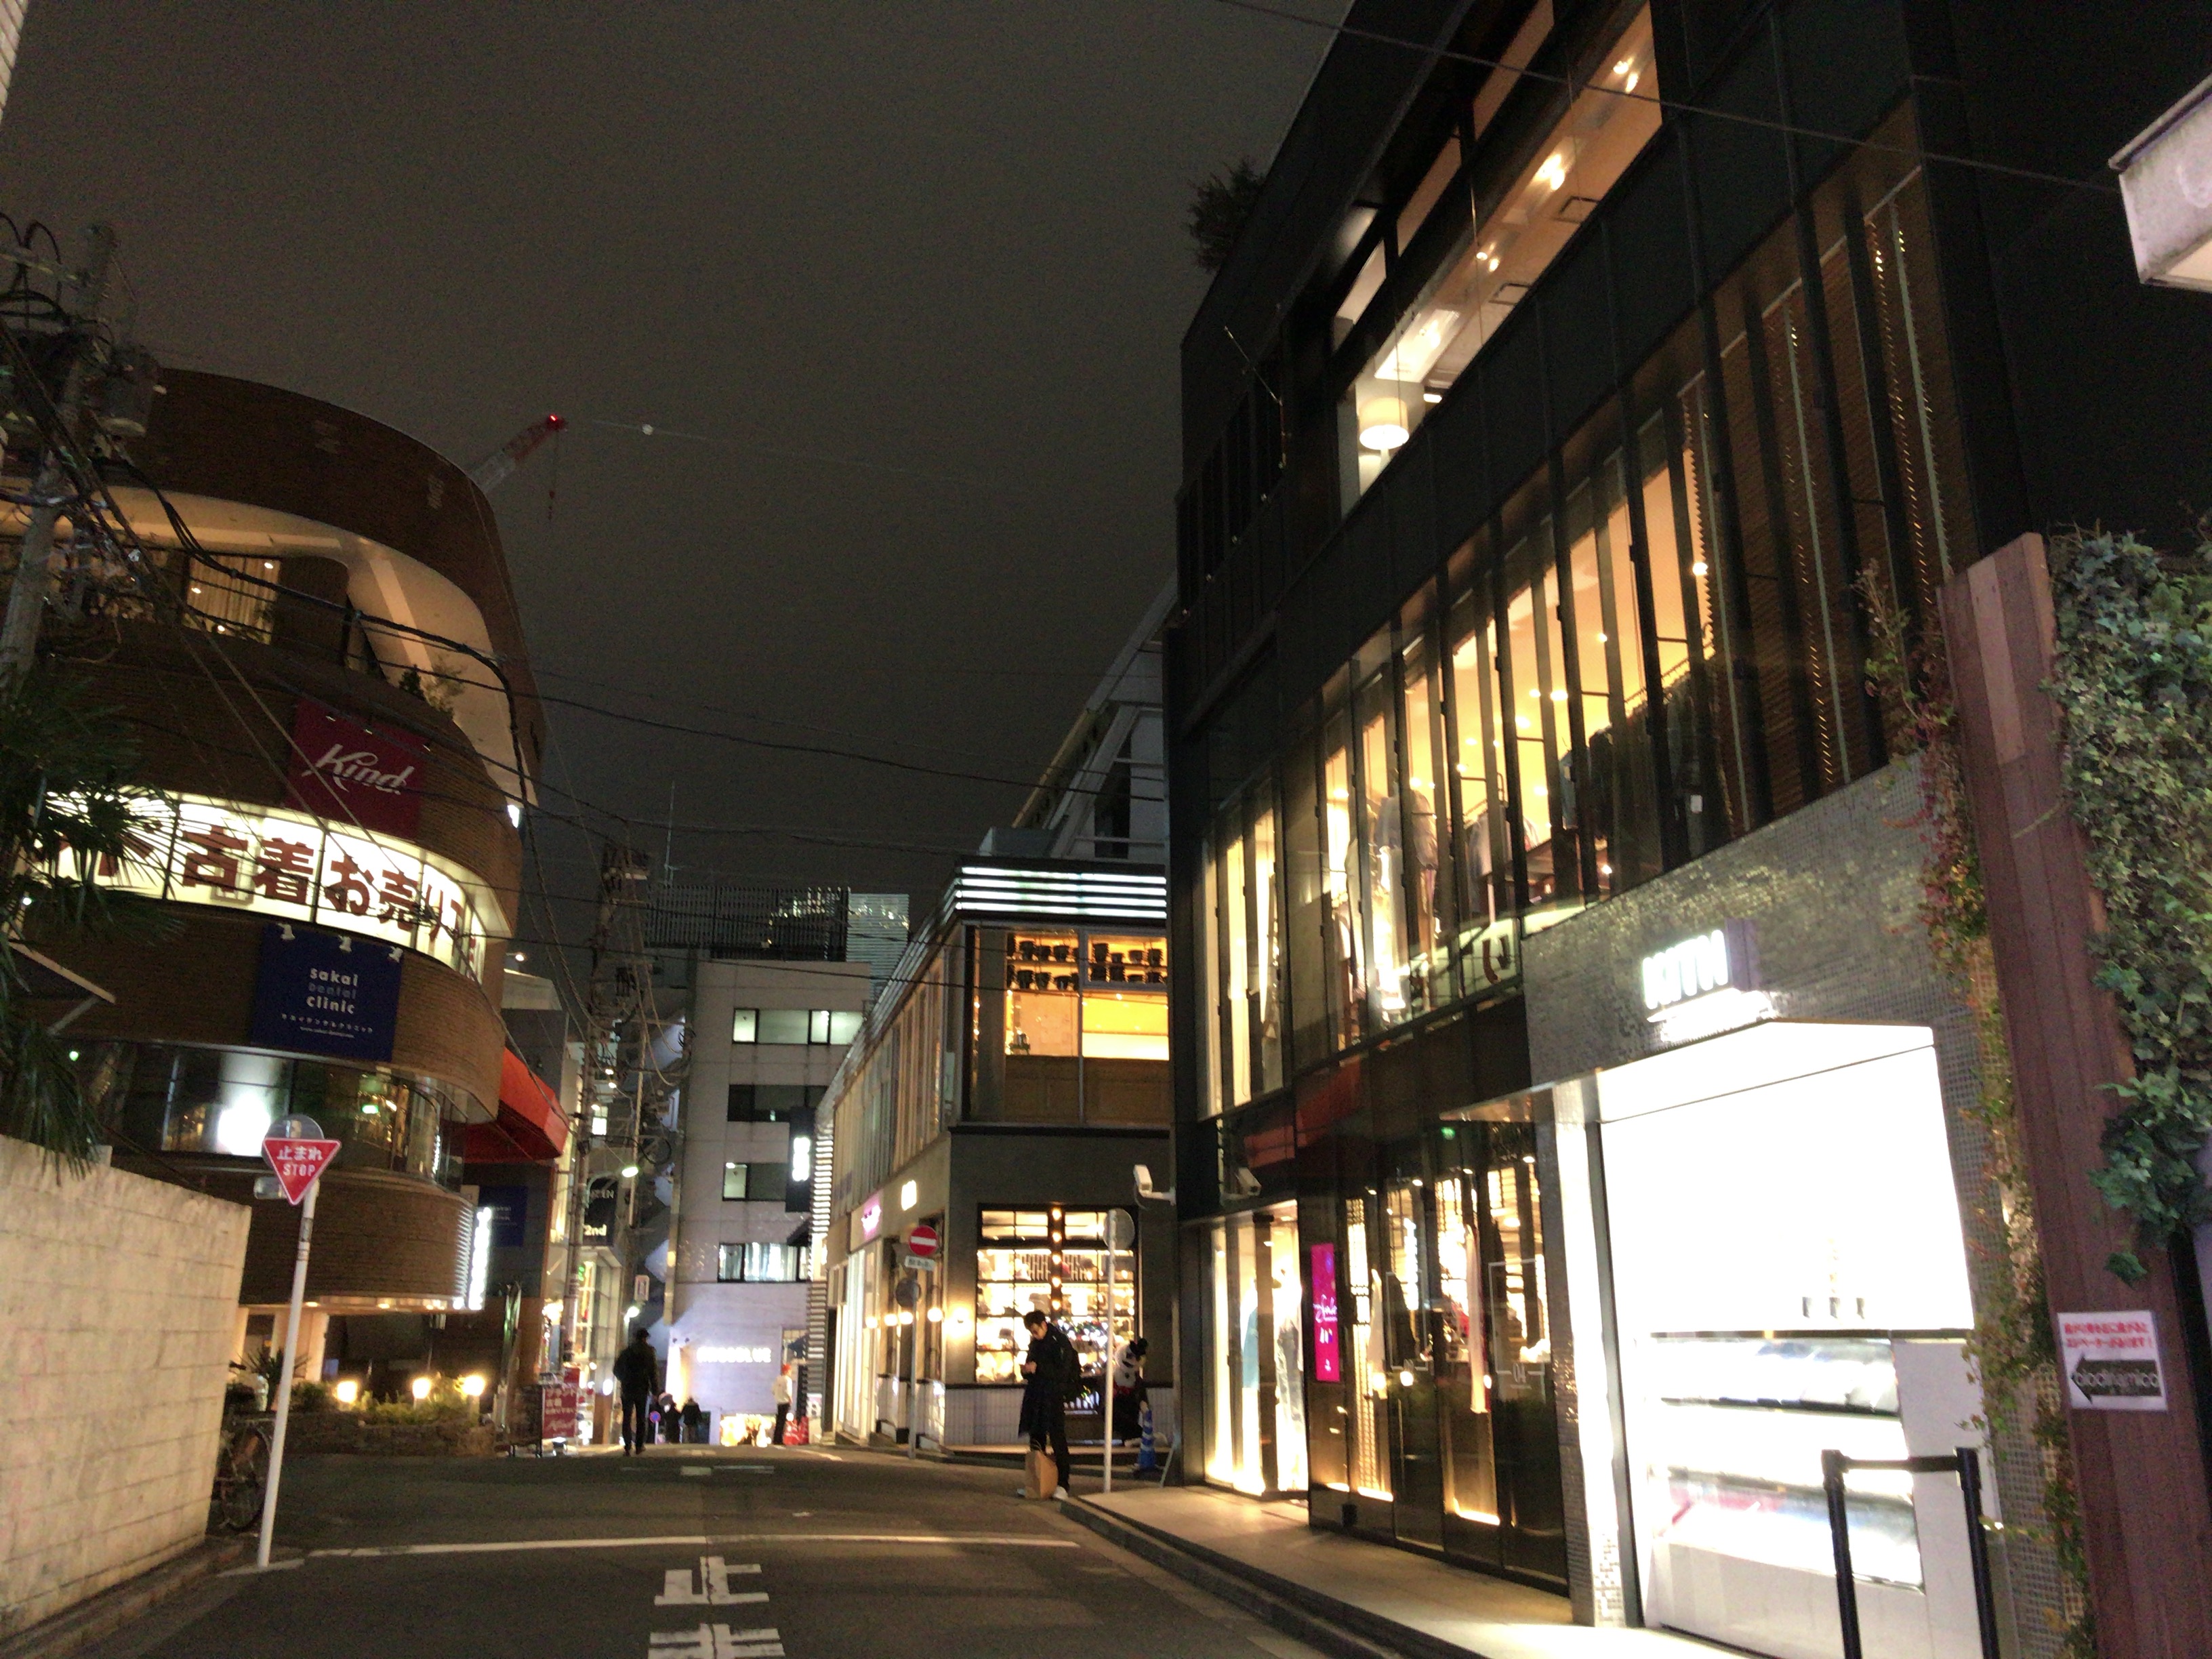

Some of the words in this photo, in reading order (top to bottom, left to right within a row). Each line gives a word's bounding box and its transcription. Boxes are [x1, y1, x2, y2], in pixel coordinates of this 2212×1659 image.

[301, 743, 415, 796] Kind
[276, 1145, 323, 1161] 止まれ
[283, 1163, 316, 1177] STOP
